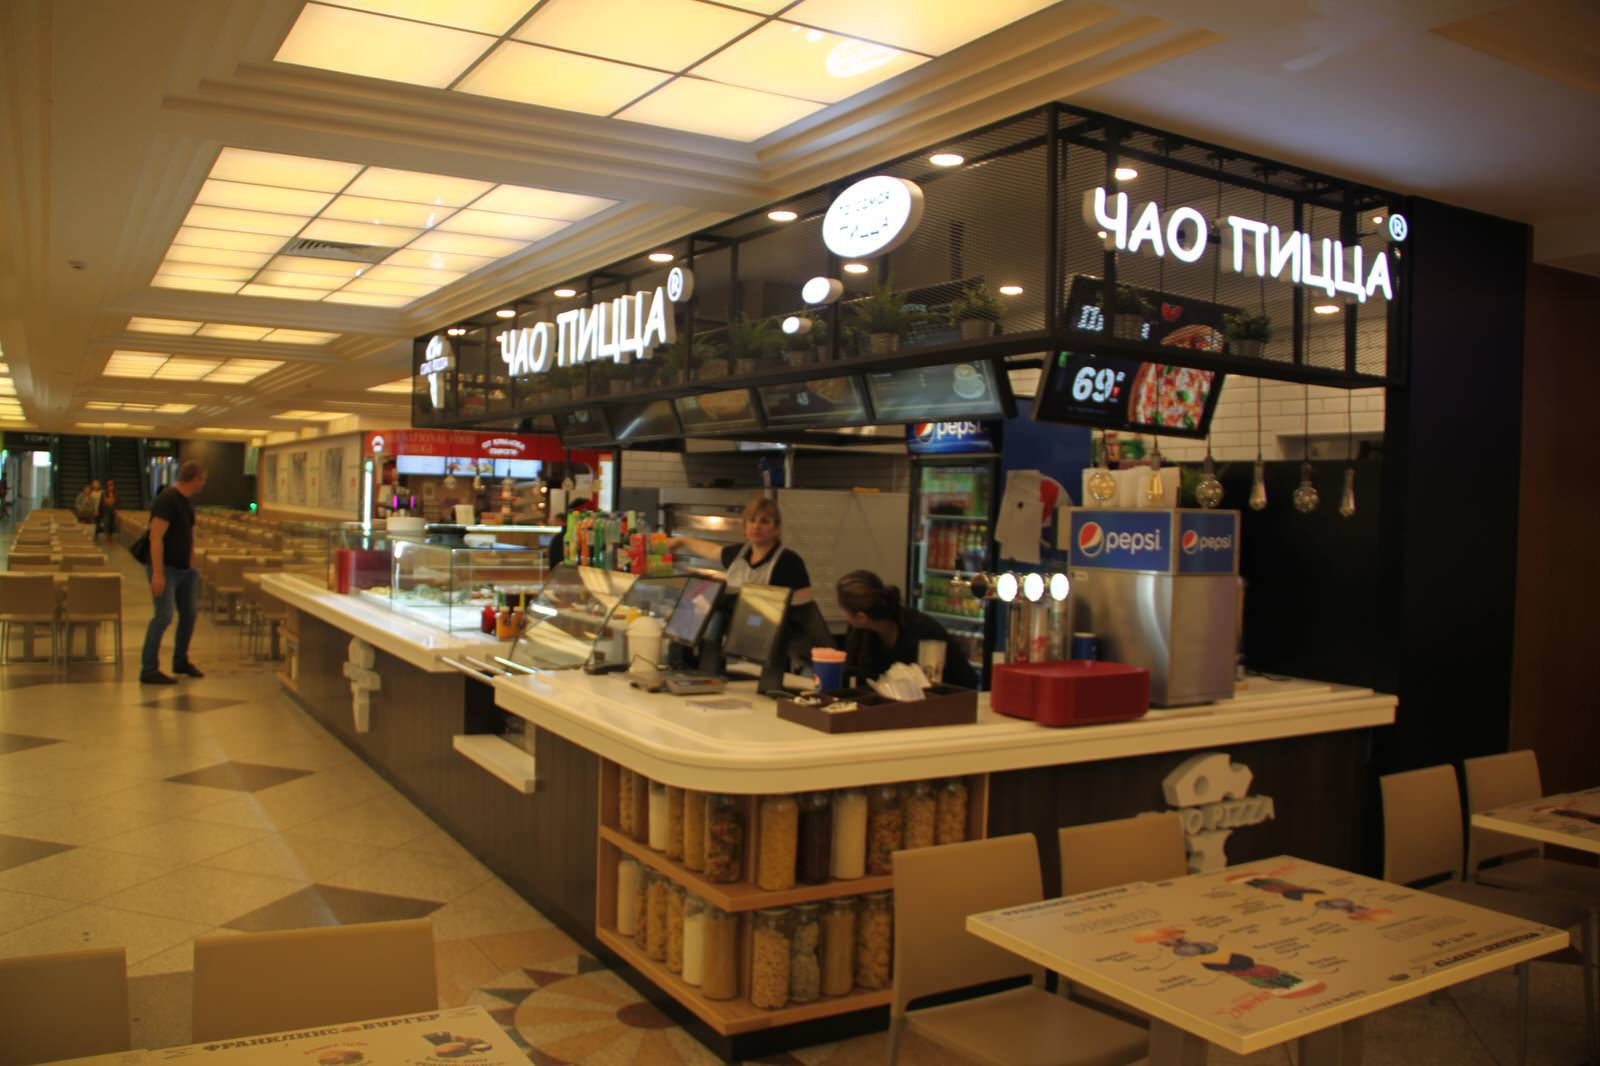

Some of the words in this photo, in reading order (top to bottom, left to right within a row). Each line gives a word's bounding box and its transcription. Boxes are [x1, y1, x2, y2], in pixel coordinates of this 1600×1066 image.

[1095, 187, 1208, 262] ЧАО
[1228, 215, 1392, 303] ПИЦЦА
[500, 321, 549, 376] ЧАО
[557, 286, 667, 367] ПИЦЦА
[1106, 529, 1161, 555] pepsi
[1200, 534, 1232, 551] pepsi
